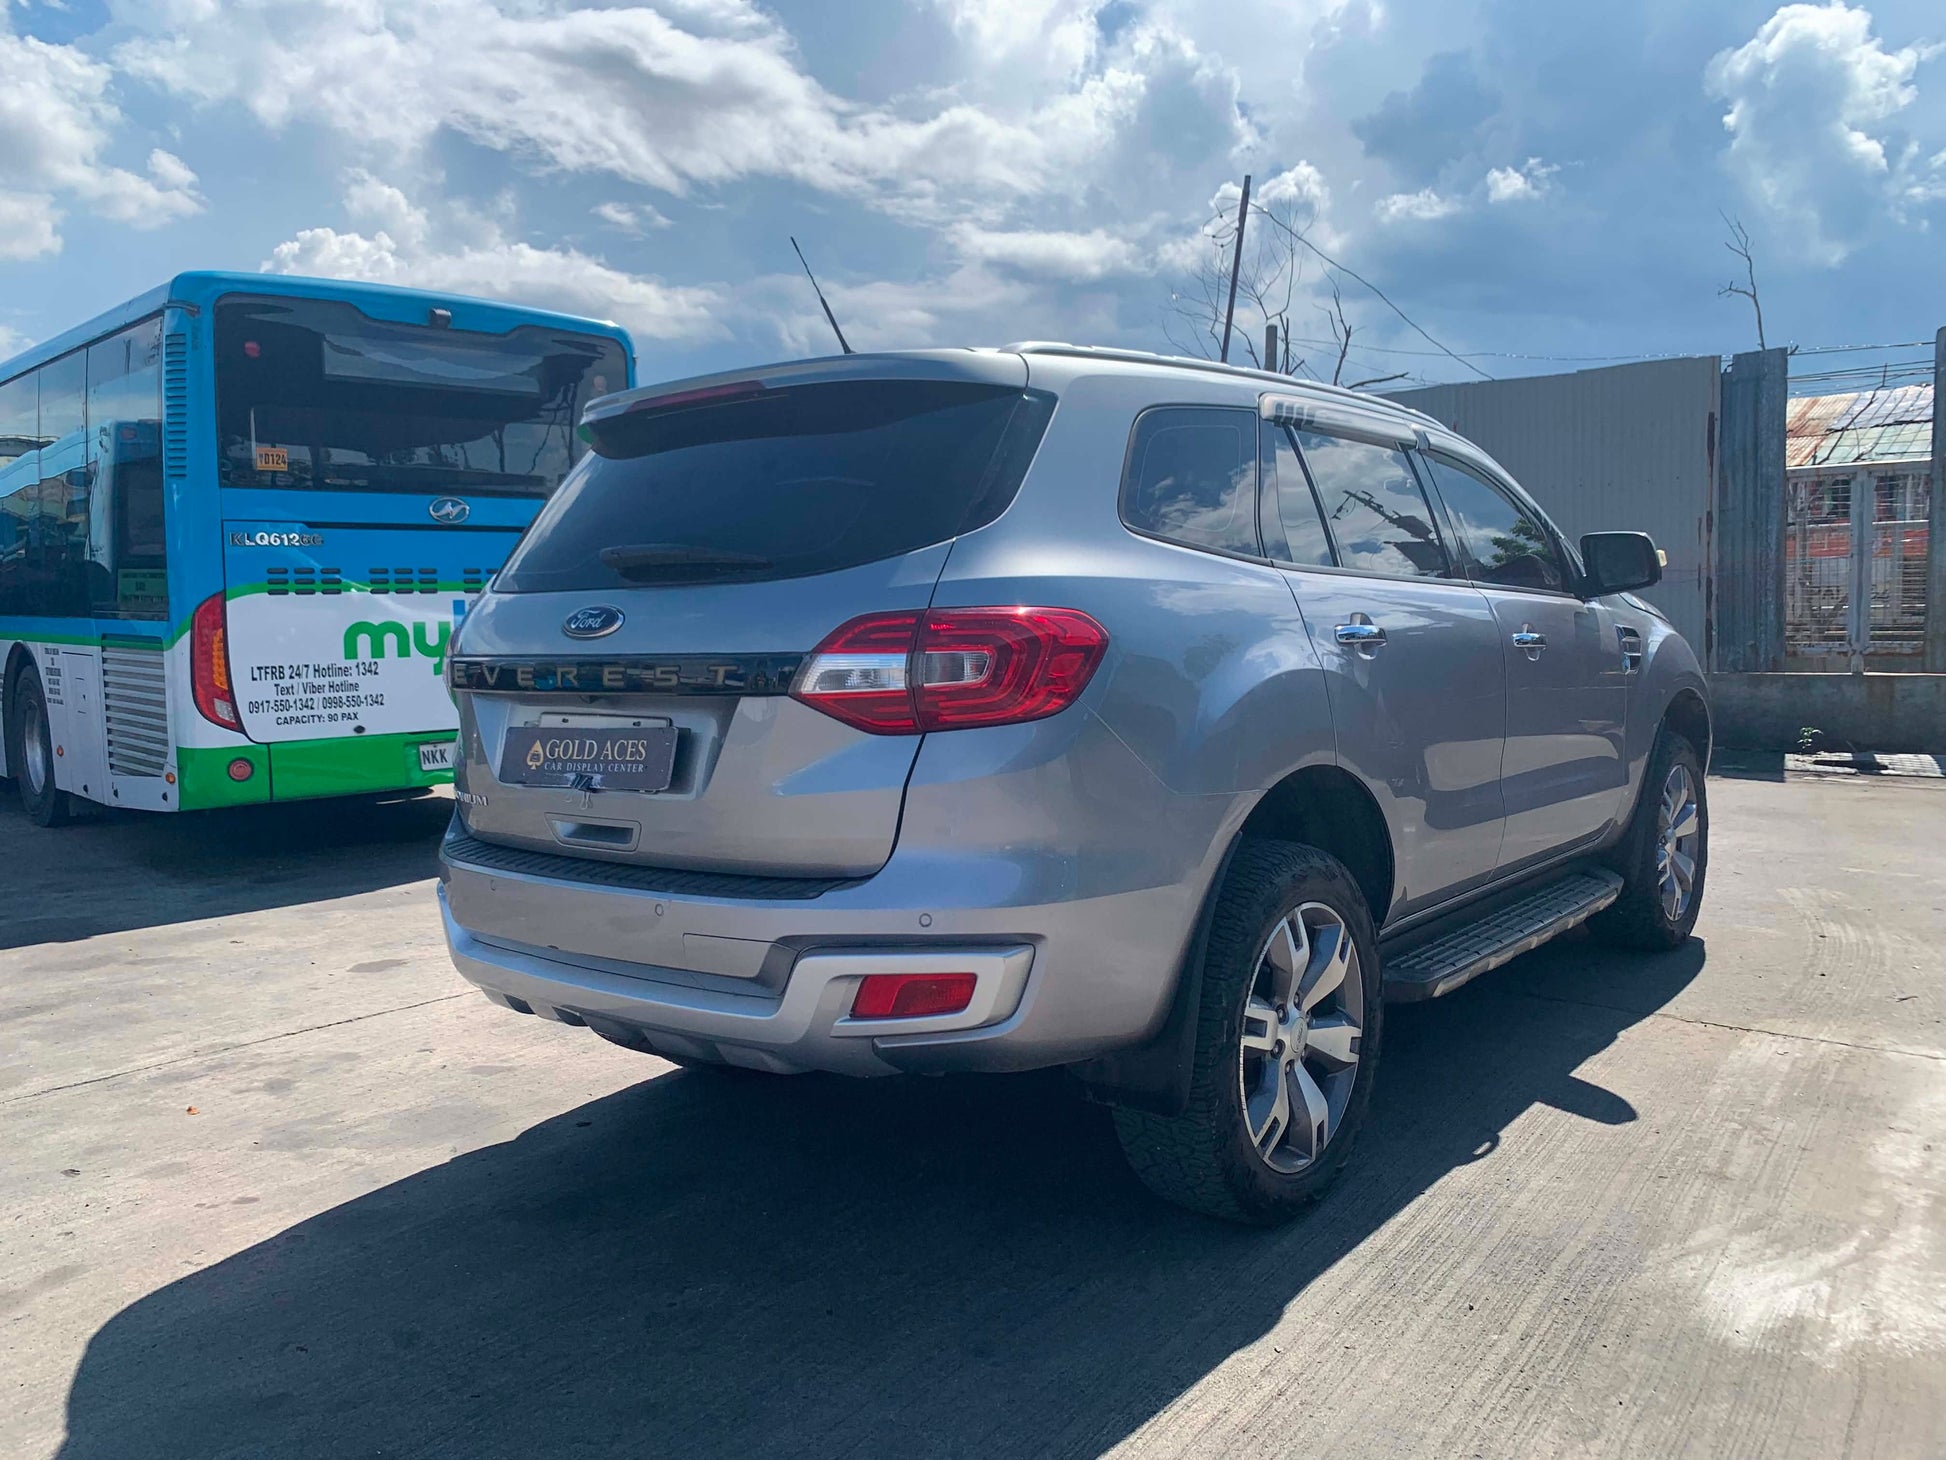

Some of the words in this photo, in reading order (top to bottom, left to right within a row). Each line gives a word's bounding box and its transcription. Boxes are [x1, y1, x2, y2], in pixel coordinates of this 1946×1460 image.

[570, 609, 607, 629] Ford
[250, 665, 286, 681] LTFRB
[288, 663, 310, 680] 24/7
[312, 662, 353, 679] Hotline:
[355, 660, 379, 677] 1342
[453, 662, 738, 688] EVEREST
[273, 682, 295, 697] Text
[301, 681, 326, 695] Viber
[328, 679, 360, 693] Hotline
[248, 697, 315, 714] 0917-550-1342
[321, 692, 385, 710] 0998-550-1342
[275, 713, 326, 726] CAPACITY:
[327, 712, 339, 723] 90
[341, 710, 360, 722] PAX
[421, 748, 449, 766] NKK
[545, 738, 598, 760] GOLD
[599, 739, 648, 761] ACES
[544, 761, 563, 771] CAR
[566, 762, 606, 772] DISPLAY
[608, 763, 645, 773] CENTER
